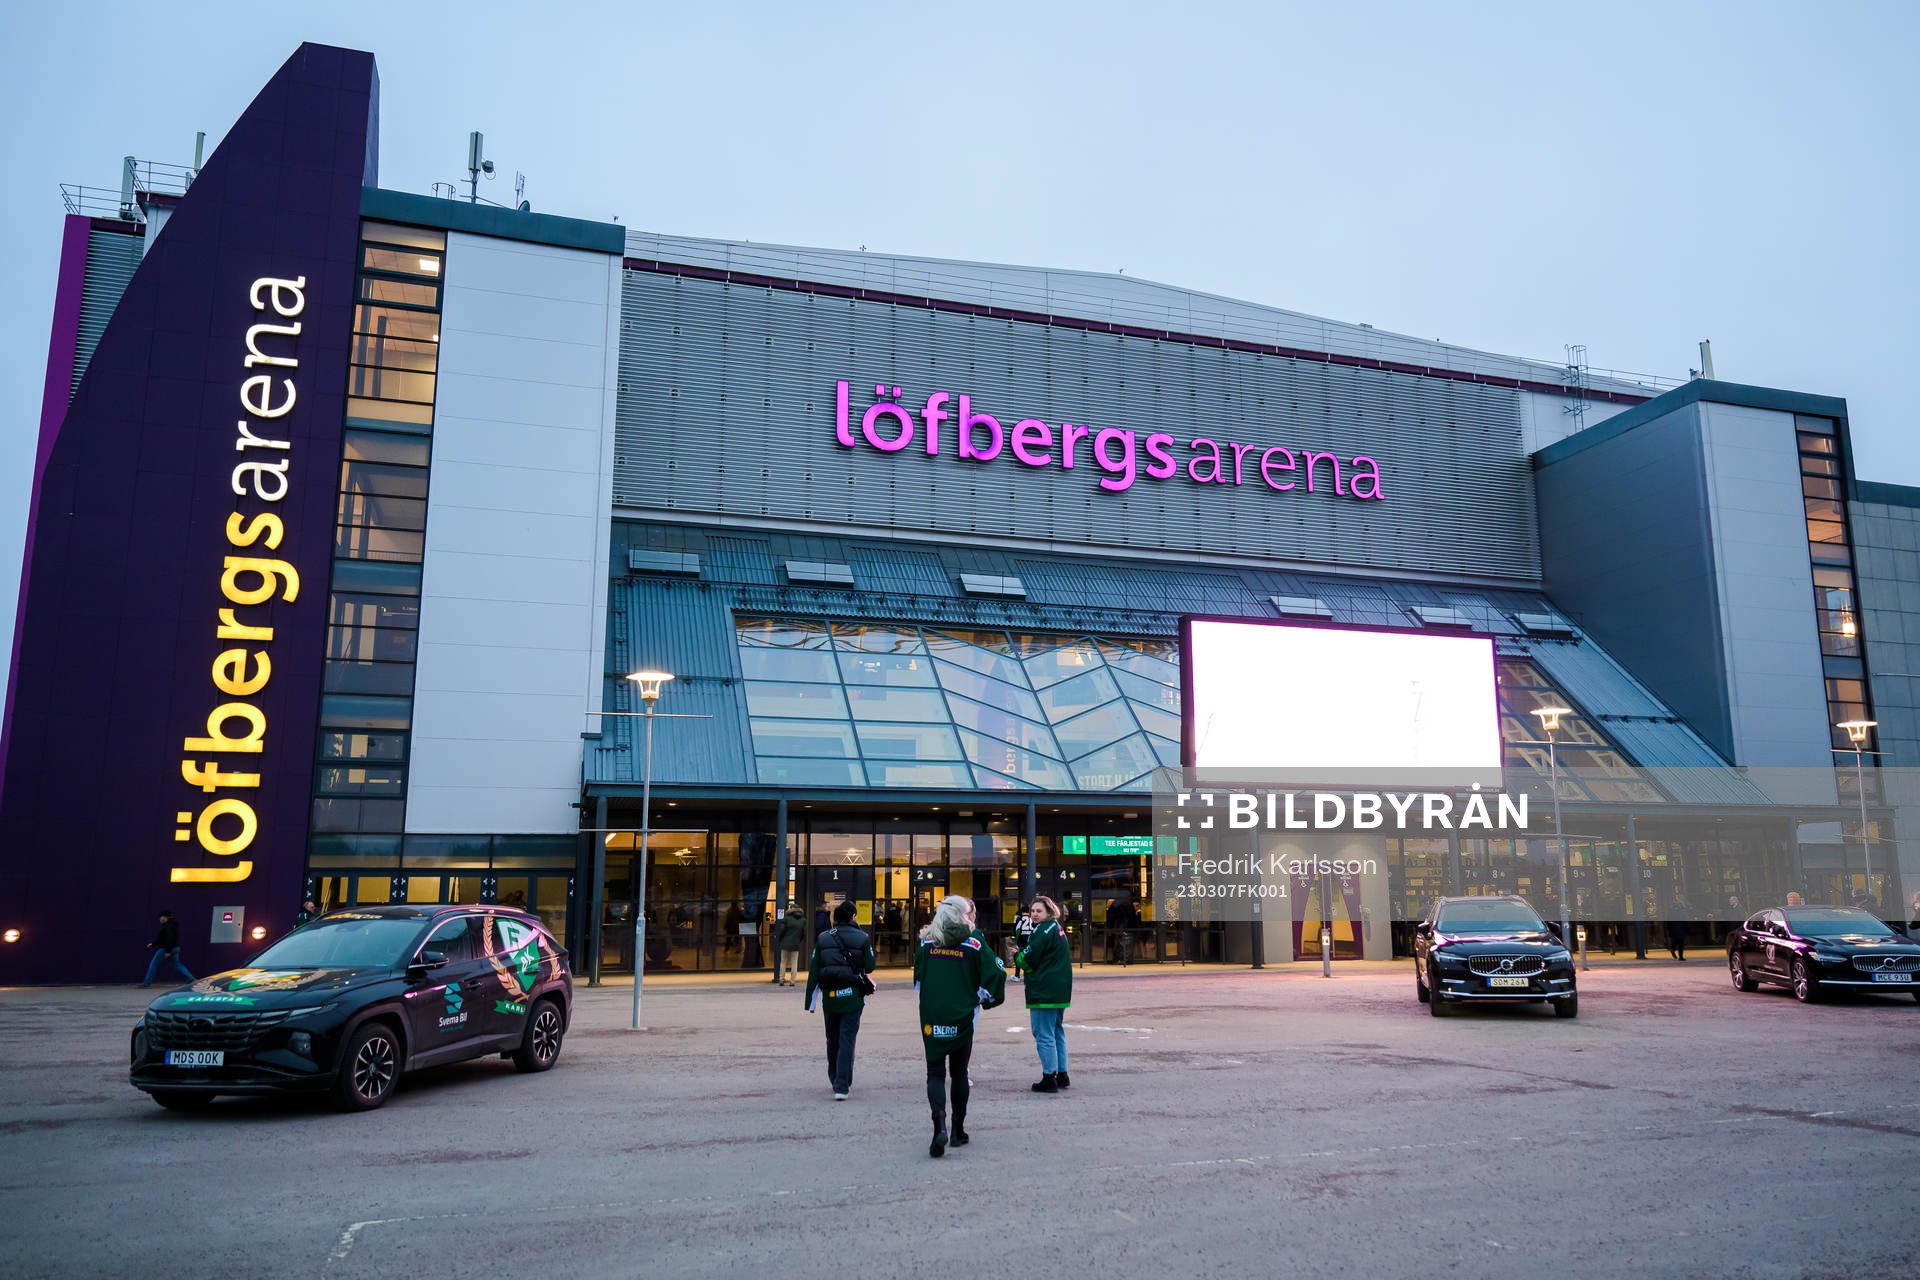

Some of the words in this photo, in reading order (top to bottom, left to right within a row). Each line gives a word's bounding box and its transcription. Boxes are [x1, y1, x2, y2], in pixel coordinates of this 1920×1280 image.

[836, 379, 1386, 500] löfbergsarena
[170, 275, 306, 883] löfbergsarena
[833, 870, 839, 880] 1
[917, 870, 924, 880] 2
[1060, 870, 1067, 880] 4
[1161, 870, 1167, 879] 5
[1465, 870, 1471, 878] 7
[1492, 870, 1498, 878] 8
[1573, 869, 1579, 878] 9
[1643, 869, 1652, 878] 10
[173, 1052, 194, 1064] MDS
